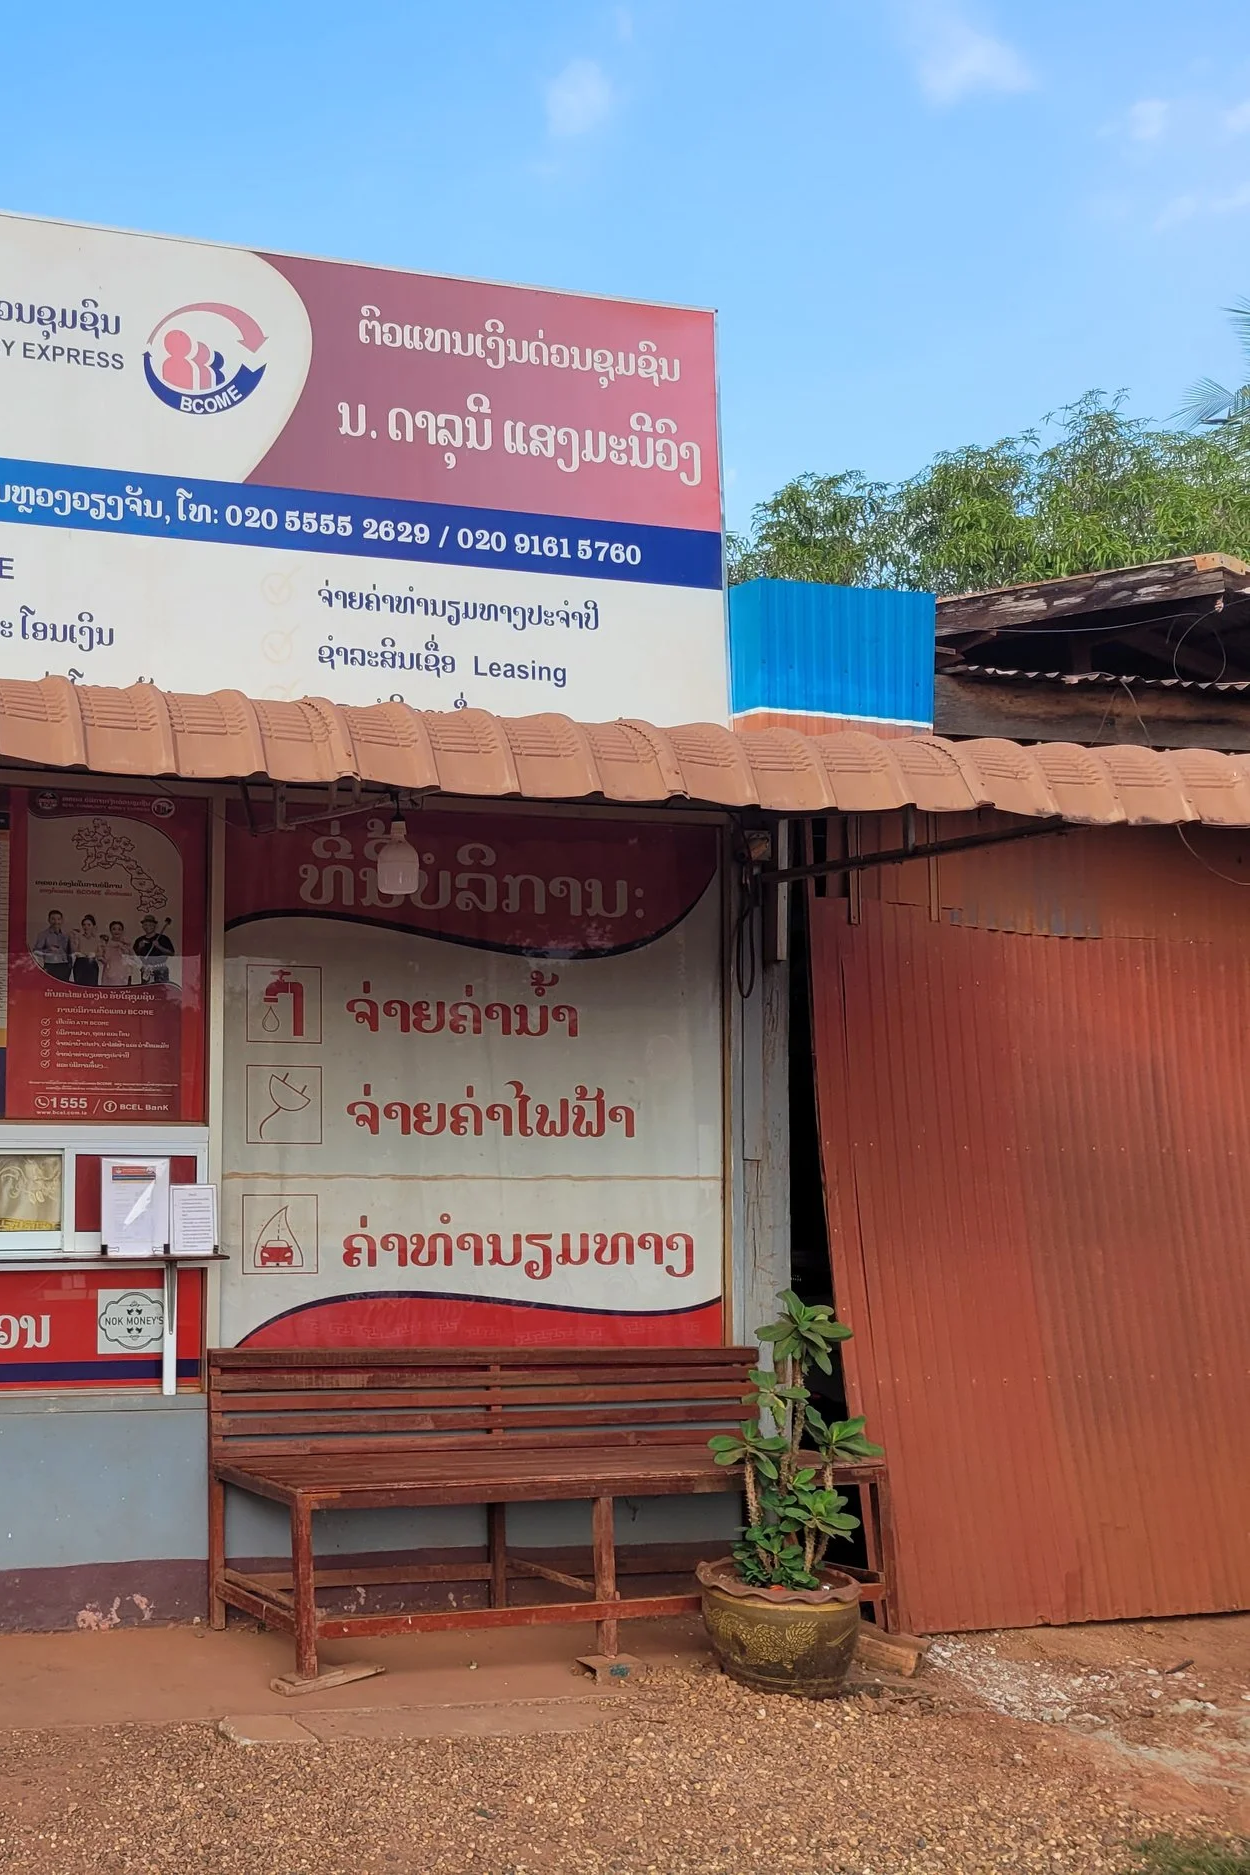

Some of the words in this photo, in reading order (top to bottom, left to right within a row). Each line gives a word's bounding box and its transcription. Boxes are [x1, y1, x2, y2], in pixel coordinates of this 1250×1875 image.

[21, 341, 125, 371] EXPRESS
[179, 385, 243, 414] BCOME
[388, 393, 492, 469] ດາລຸນີ
[176, 489, 218, 525] ໂທ:
[225, 504, 278, 532] 020
[284, 509, 353, 537] 5555
[362, 518, 430, 545] 2629
[438, 525, 450, 548] /
[457, 527, 507, 553] 020
[514, 534, 571, 559] 9161
[577, 538, 641, 566] 5760
[19, 605, 115, 652] ໂອນເງິນ
[473, 655, 567, 688] Leasing
[50, 1098, 88, 1109] 1555
[119, 1103, 144, 1111] BCEL
[346, 1080, 635, 1139] ຈ່າຍຄ່າໄຟຟ້າ
[105, 1316, 124, 1326] NOK
[126, 1316, 164, 1325] MONEY'S
